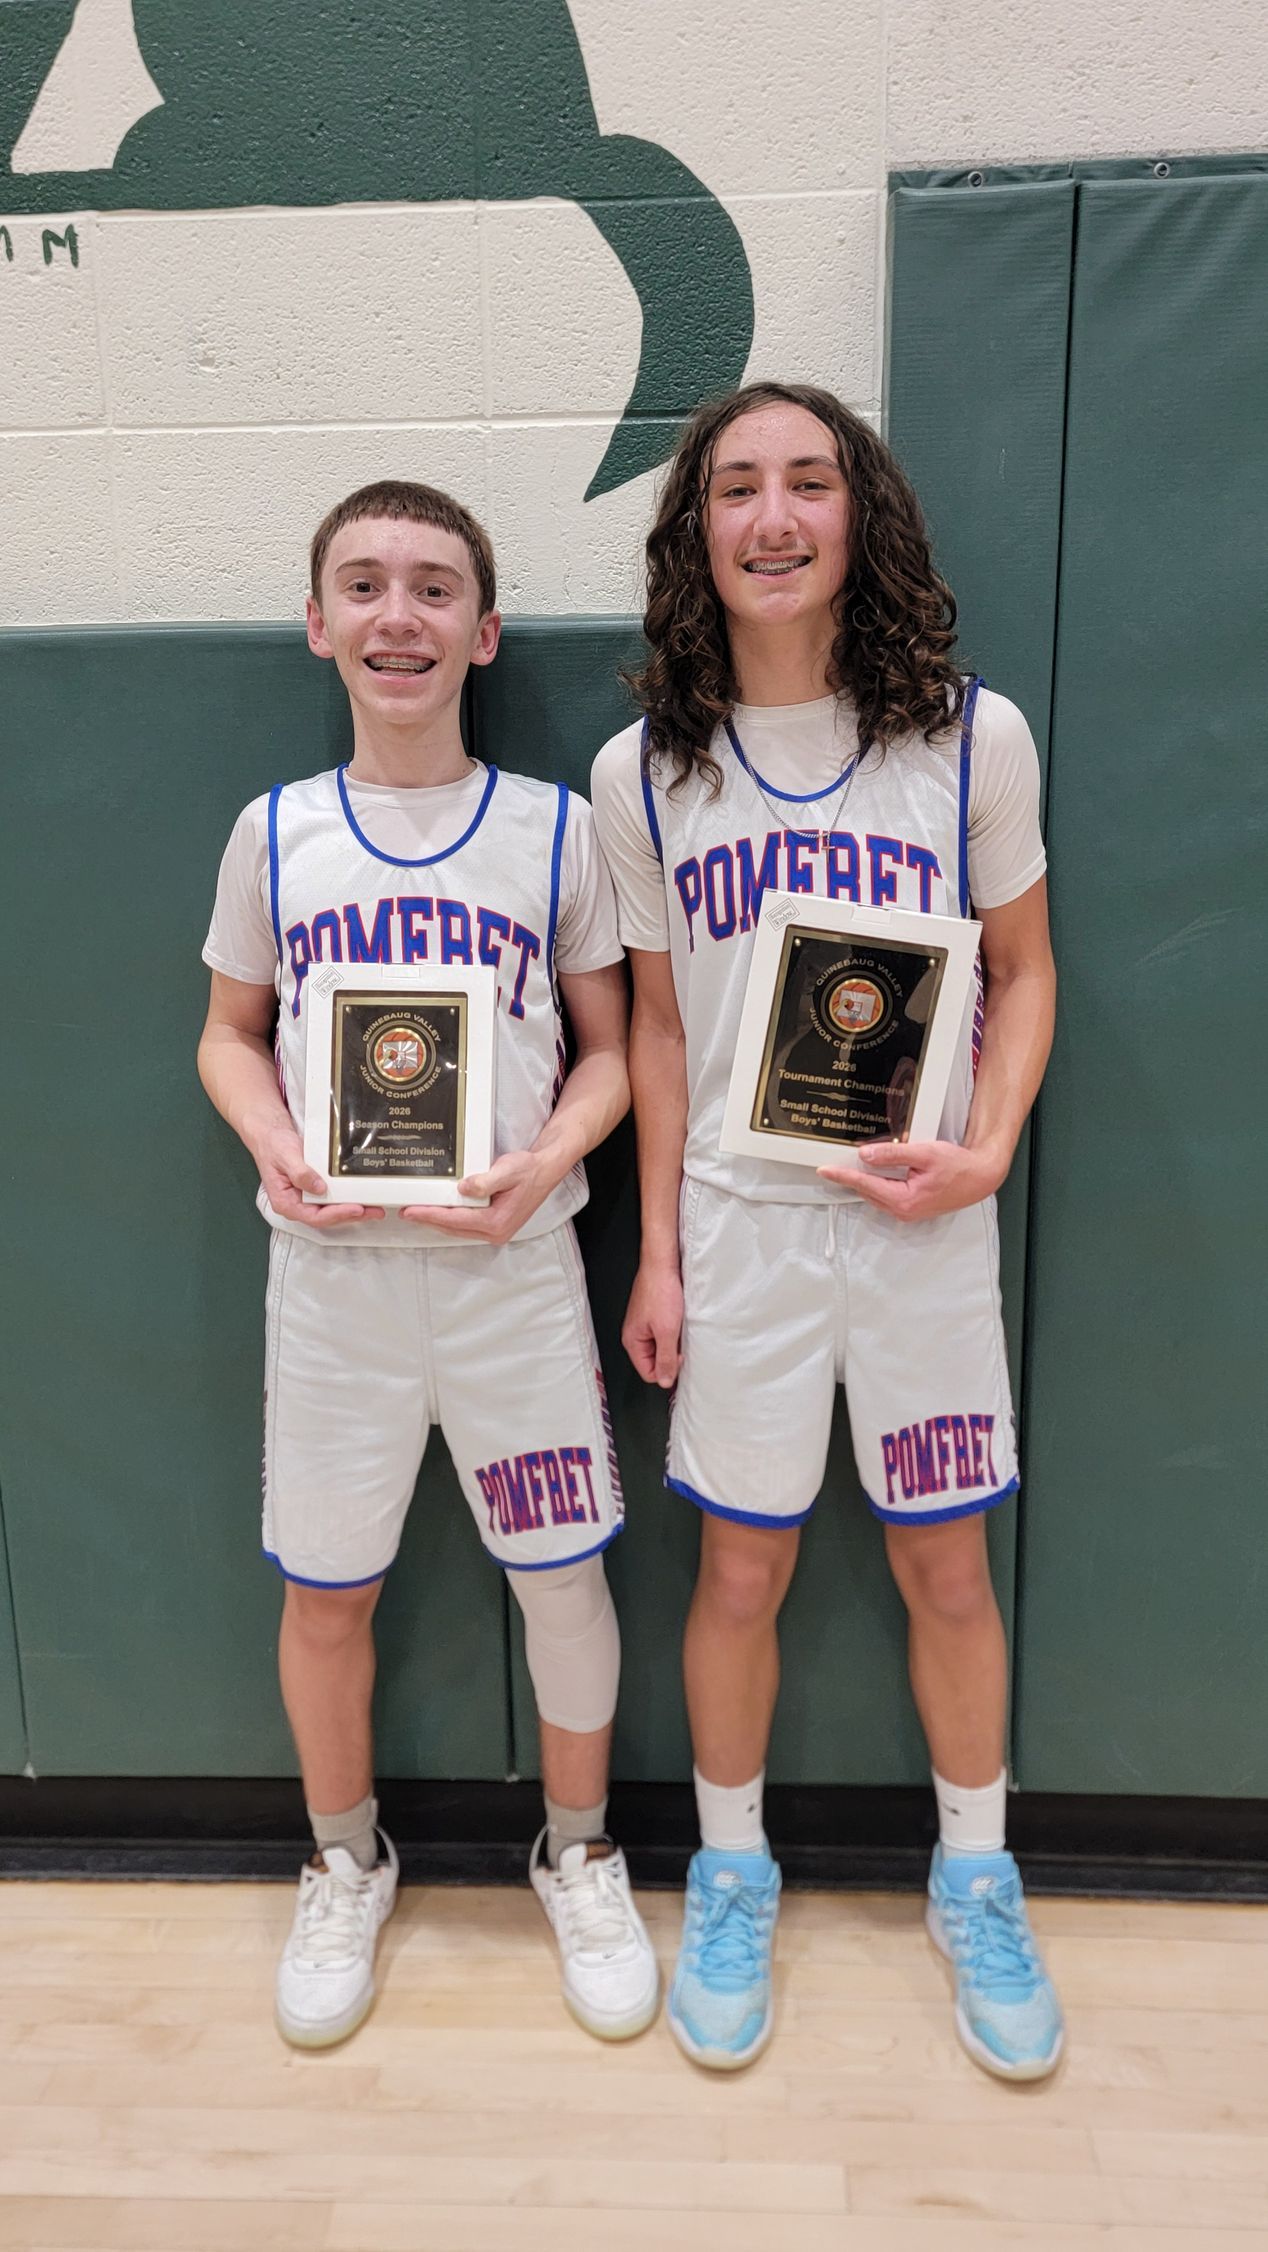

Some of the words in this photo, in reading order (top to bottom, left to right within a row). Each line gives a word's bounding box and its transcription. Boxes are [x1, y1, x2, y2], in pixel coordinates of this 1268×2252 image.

[674, 829, 943, 953] POMFRET
[285, 896, 541, 1020] POMFRET
[816, 957, 875, 986] QUINEBAUG
[877, 963, 903, 998] VALLEY
[362, 1012, 411, 1042] QUINEBAUG
[413, 1014, 441, 1042] VALLEY
[809, 1007, 833, 1043] JUNIOR
[833, 1019, 899, 1052] CONFERENCE
[832, 1060, 856, 1072] 2026
[360, 1064, 385, 1095] JUNIOR
[386, 1066, 442, 1100] CONFERENCE
[778, 1069, 841, 1087] Tournament
[844, 1079, 905, 1097] Champions
[355, 1120, 389, 1129] Season
[391, 1120, 444, 1131] Champions
[388, 1107, 411, 1115] 2026
[780, 1099, 809, 1112] Small
[811, 1103, 847, 1117] School
[849, 1109, 891, 1124] Division
[790, 1113, 821, 1127] Boys'
[822, 1117, 876, 1134] Basketball
[352, 1146, 377, 1155] Small
[378, 1146, 408, 1155] School
[410, 1146, 445, 1156] Division
[363, 1158, 388, 1168] Boys'
[389, 1159, 434, 1168] Basketball
[880, 1413, 998, 1504] POMFRET
[474, 1447, 599, 1536] POMFRET
